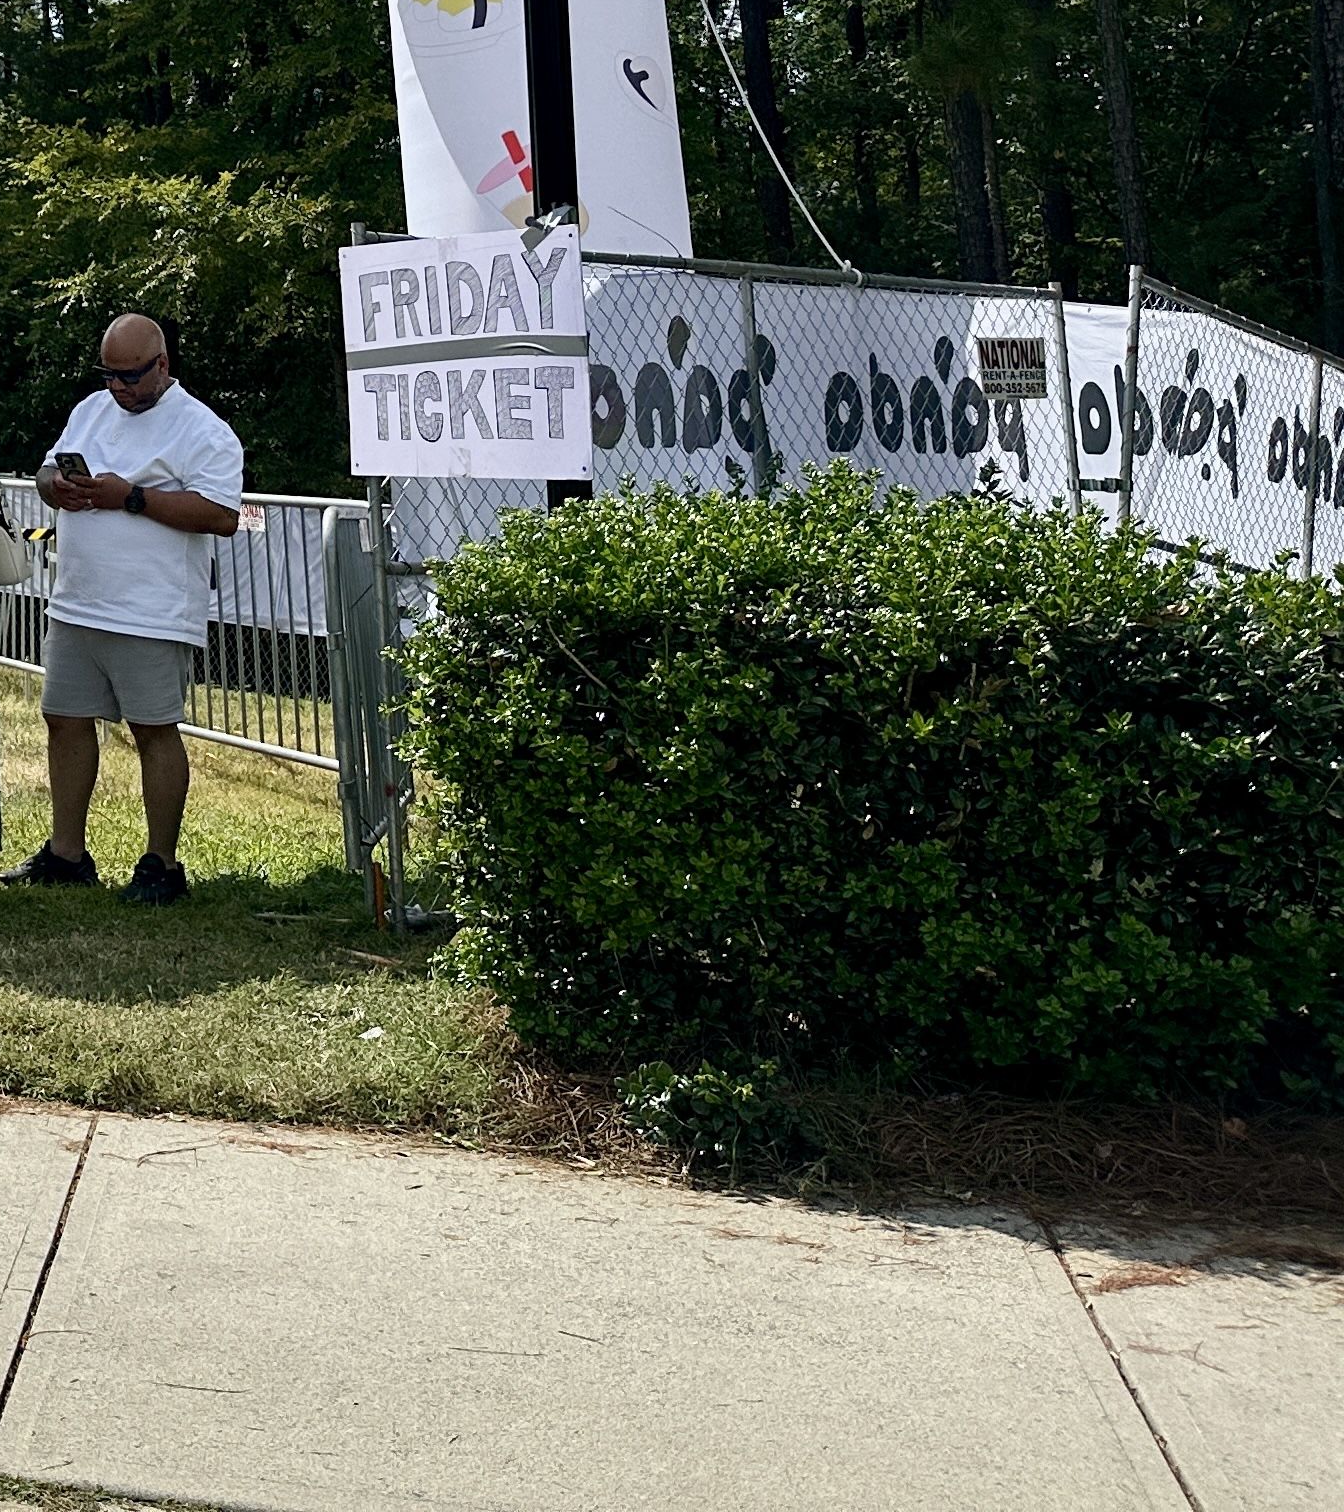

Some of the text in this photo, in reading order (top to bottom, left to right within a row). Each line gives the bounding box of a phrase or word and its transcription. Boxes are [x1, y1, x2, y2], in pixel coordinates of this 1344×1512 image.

[358, 247, 568, 343] FRIDAY
[979, 339, 1046, 370] NATIONAL
[982, 370, 1047, 381] RENT-A-FENCE
[983, 382, 1047, 394] 800-352-5675
[363, 365, 575, 443] TICKET
